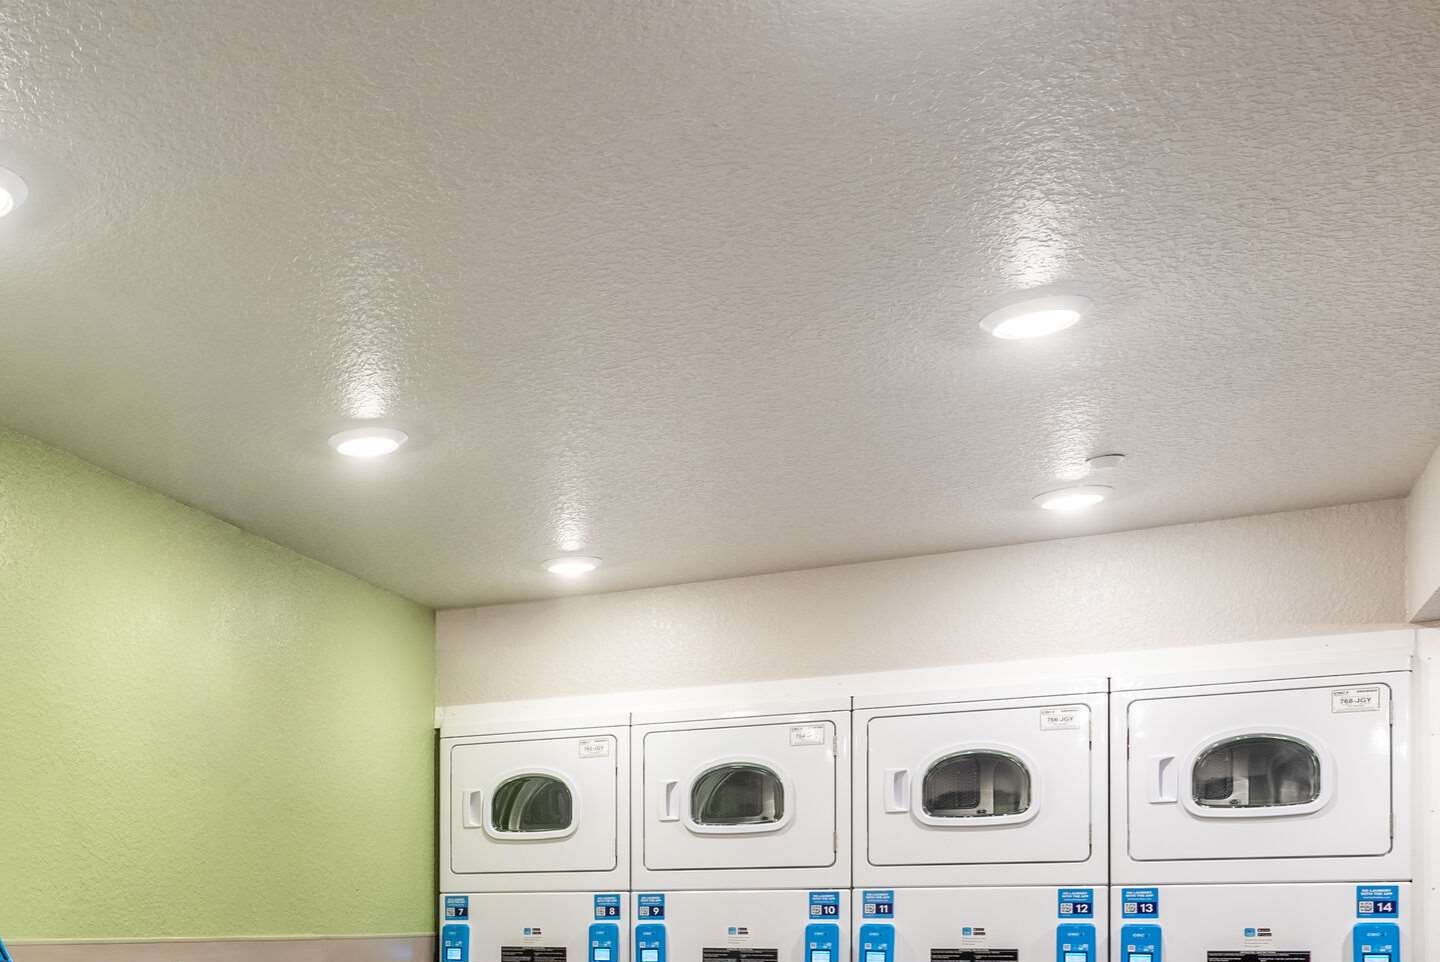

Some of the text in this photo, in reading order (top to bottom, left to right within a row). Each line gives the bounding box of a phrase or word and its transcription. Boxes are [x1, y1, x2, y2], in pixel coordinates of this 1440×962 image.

[823, 906, 836, 914] 10
[879, 904, 888, 913] 11
[1075, 904, 1088, 913] 12
[1140, 904, 1154, 912] 13
[1376, 902, 1392, 912] 14
